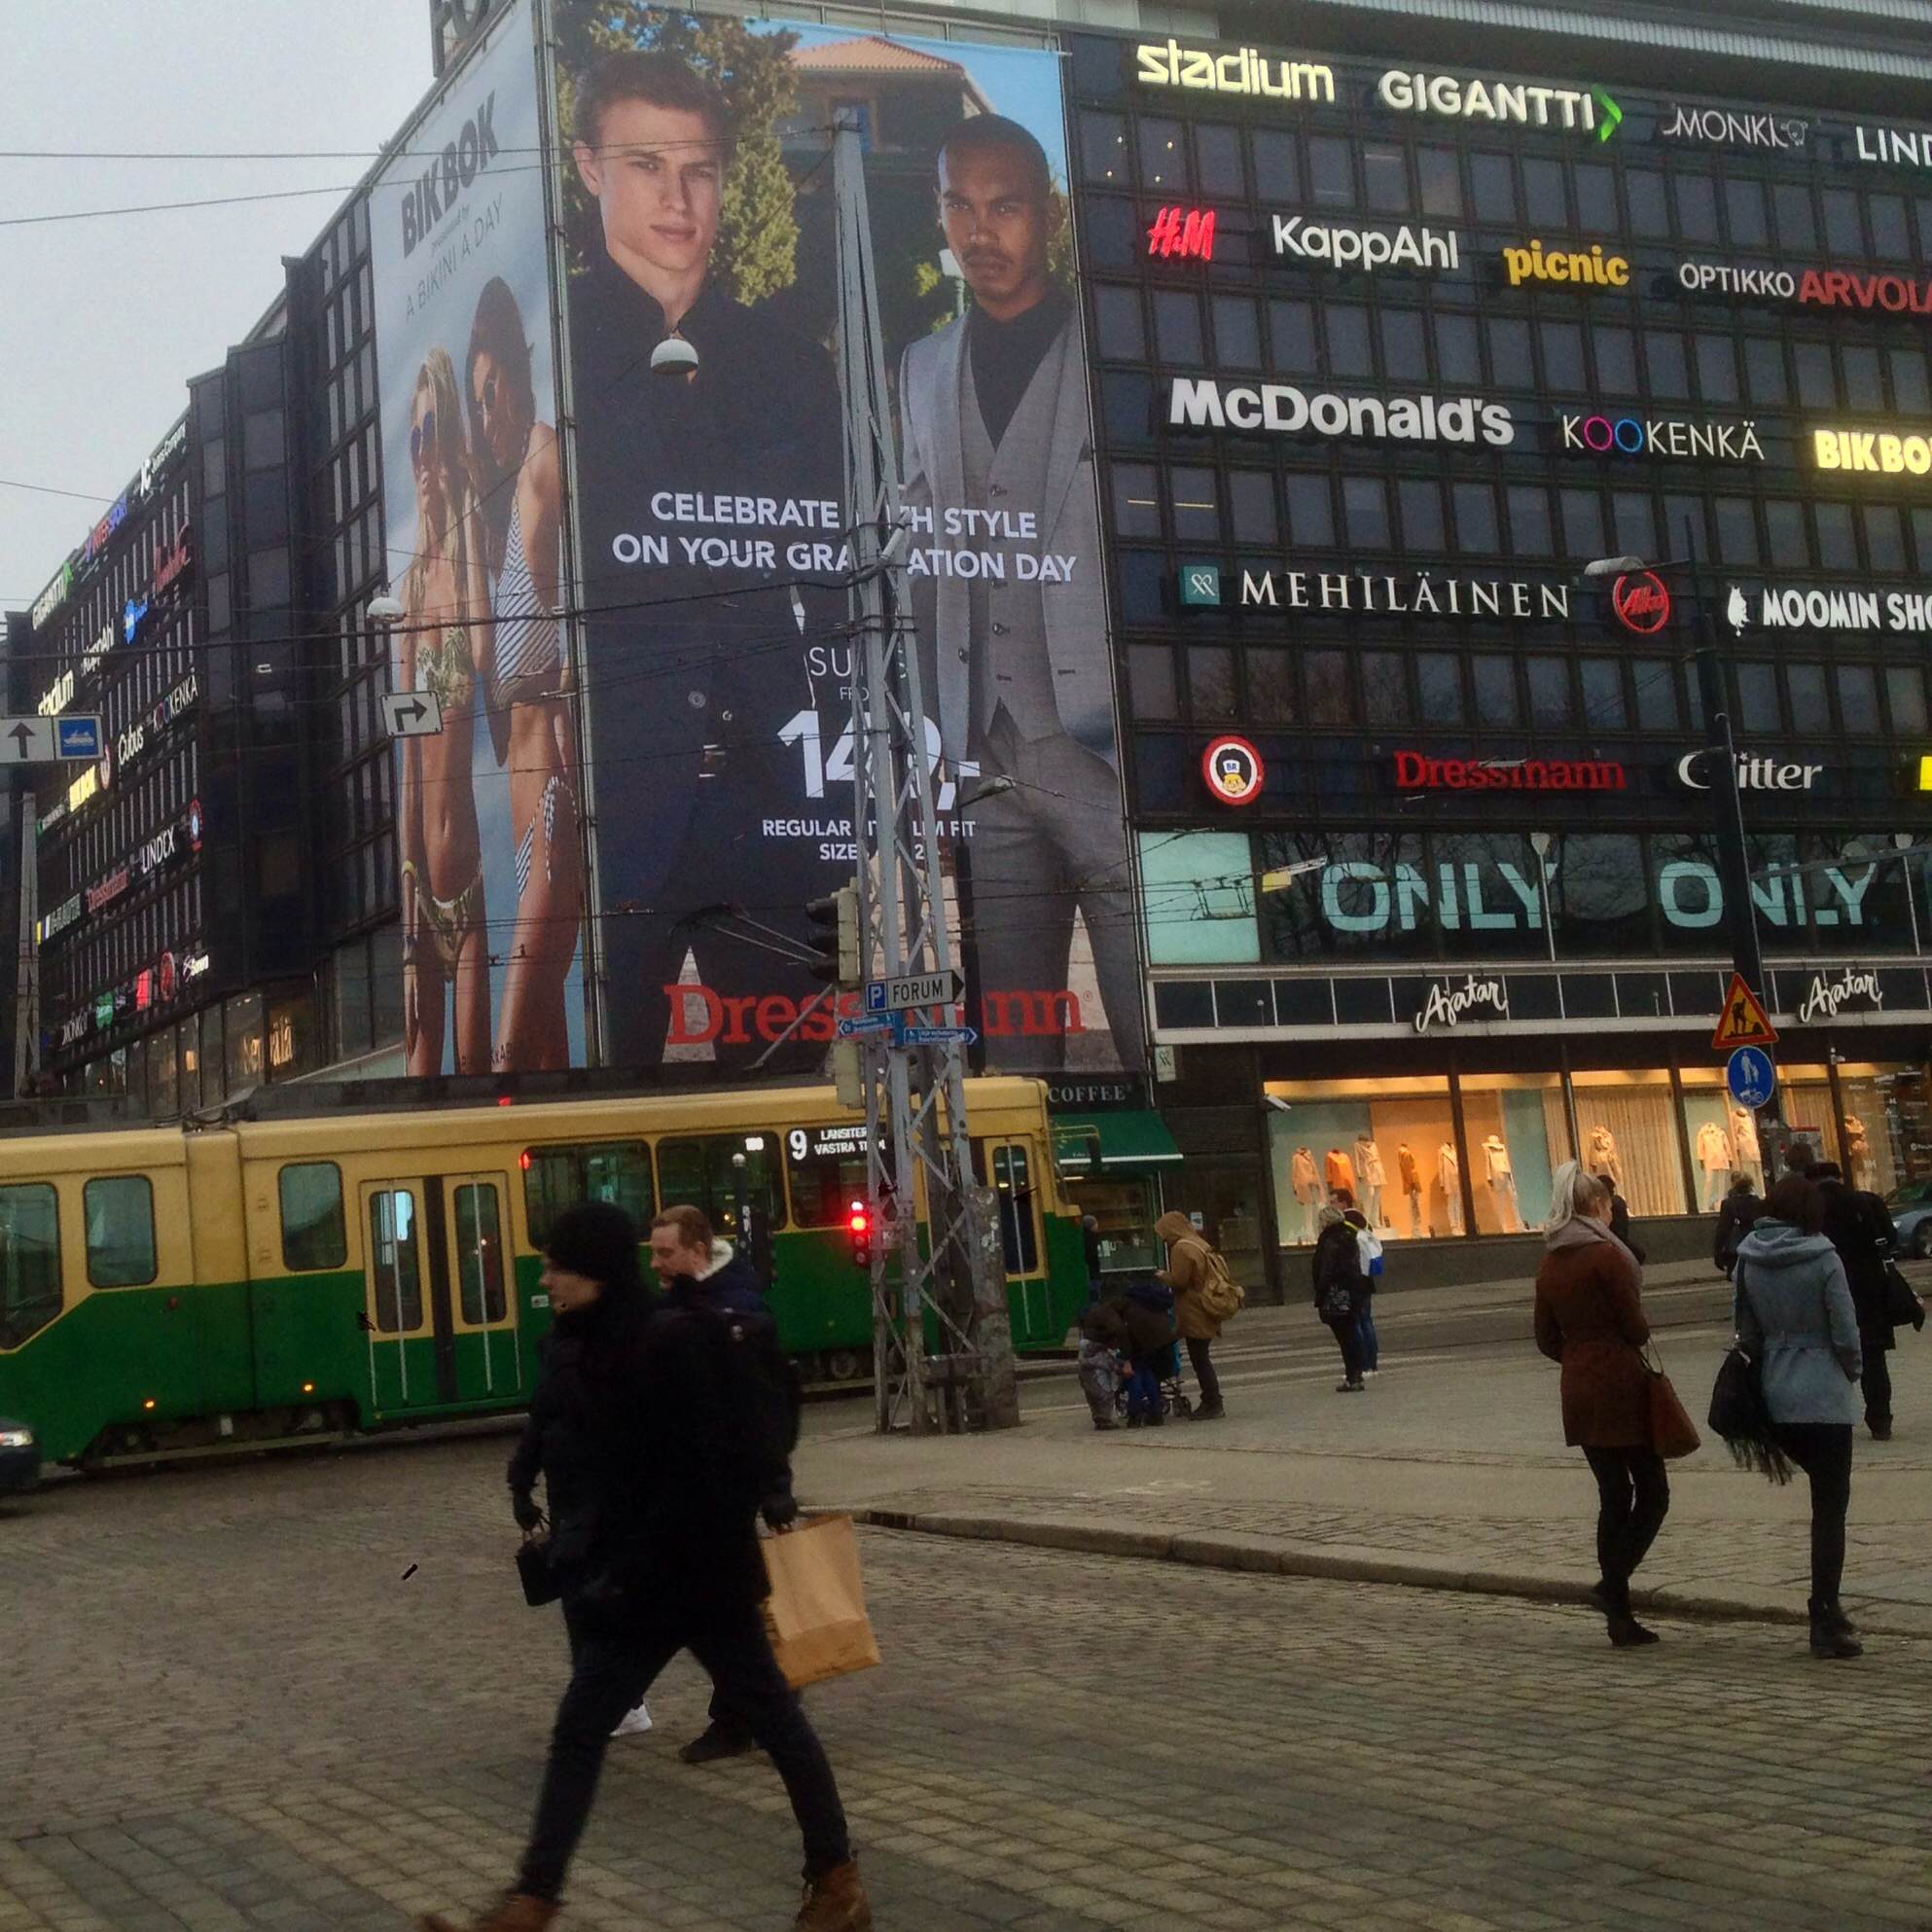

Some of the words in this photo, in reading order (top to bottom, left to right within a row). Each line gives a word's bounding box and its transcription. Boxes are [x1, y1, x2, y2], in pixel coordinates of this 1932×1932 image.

[1137, 39, 1335, 102] stadium
[1377, 70, 1595, 130] GIGANTTI
[402, 89, 498, 259] BIKBOK
[1148, 207, 1215, 262] H&M
[1272, 214, 1459, 271] KappAhl
[1503, 239, 1630, 286] picnic
[1680, 263, 1795, 298] OPTIKKO
[1170, 377, 1516, 447] McDonald's
[1562, 414, 1765, 460] KOOKENKÄ
[1814, 429, 1932, 475] BIKBO
[651, 491, 840, 529] CELEBRATE
[944, 508, 1037, 539] STYLE
[612, 534, 668, 564] ON
[678, 536, 776, 569] YOUR
[786, 544, 1005, 579] GRAATION
[1017, 554, 1077, 582] DAY
[1240, 569, 1569, 619] MEHILÄINEN
[1763, 588, 1881, 629] MOOMIN
[1395, 751, 1626, 790] Dressmann
[1678, 749, 1822, 790] Gitter
[141, 825, 176, 874] LINDEX
[763, 819, 851, 837] REGULAR
[819, 843, 858, 860] SIZE
[1322, 862, 1557, 931] ONLY
[870, 984, 883, 1009] P
[893, 979, 943, 1003] FORUM
[1048, 1085, 1126, 1103] COFFEE
[790, 1129, 807, 1161] 9
